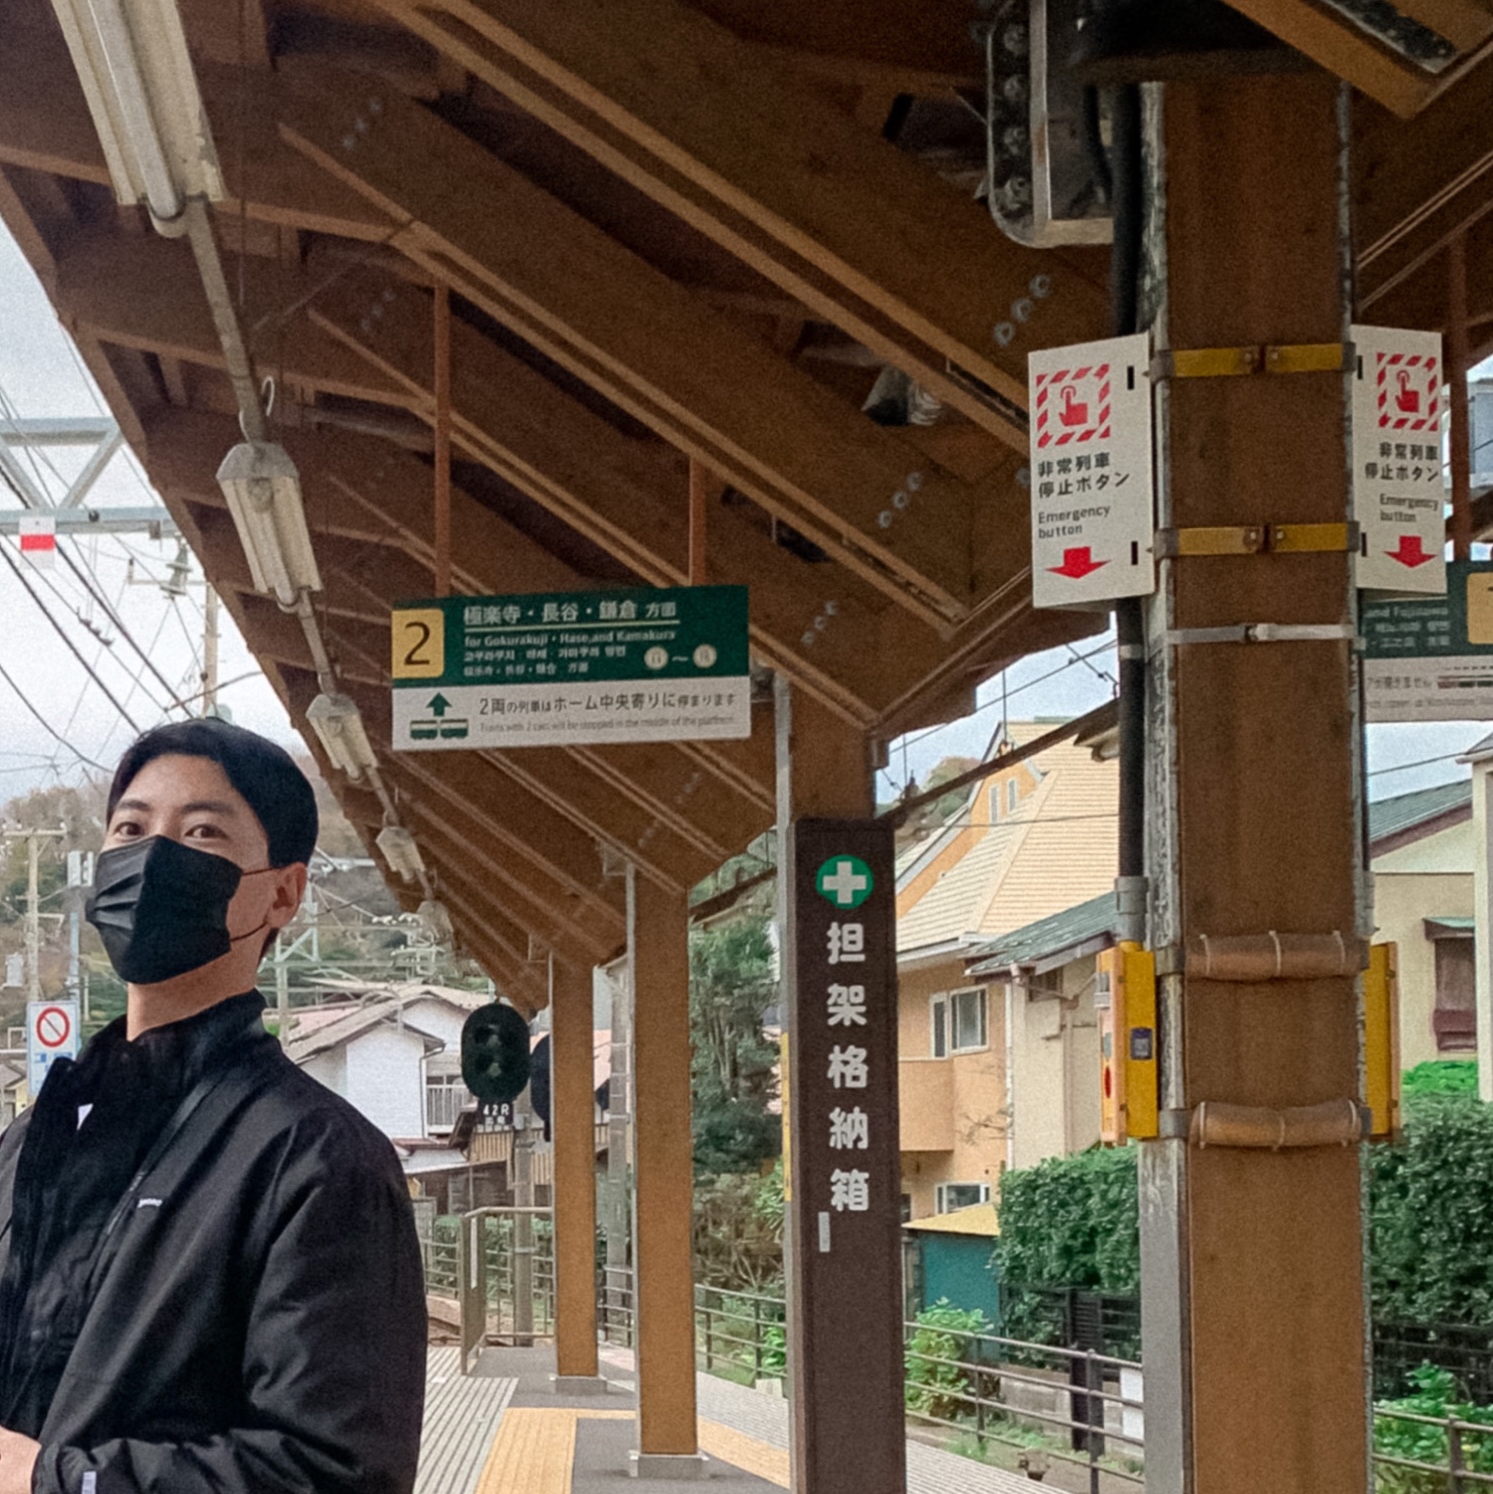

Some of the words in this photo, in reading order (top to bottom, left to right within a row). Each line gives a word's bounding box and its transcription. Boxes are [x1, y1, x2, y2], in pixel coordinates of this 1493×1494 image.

[1379, 441, 1438, 460] 非常列車
[1038, 452, 1110, 478] 非常列車
[1365, 461, 1439, 482] 停止ボタン
[1038, 473, 1130, 499] 停止ボタン
[1380, 493, 1439, 511] Emergency
[1038, 505, 1111, 524] Emergency
[1380, 509, 1417, 522] button
[1038, 524, 1083, 539] button
[404, 621, 430, 666] 2
[464, 635, 482, 648] for
[484, 632, 549, 647] Gokurakuji
[616, 629, 676, 642] Kamakura
[826, 921, 870, 1213] 担架格納箱
[482, 1102, 509, 1117] 42R
